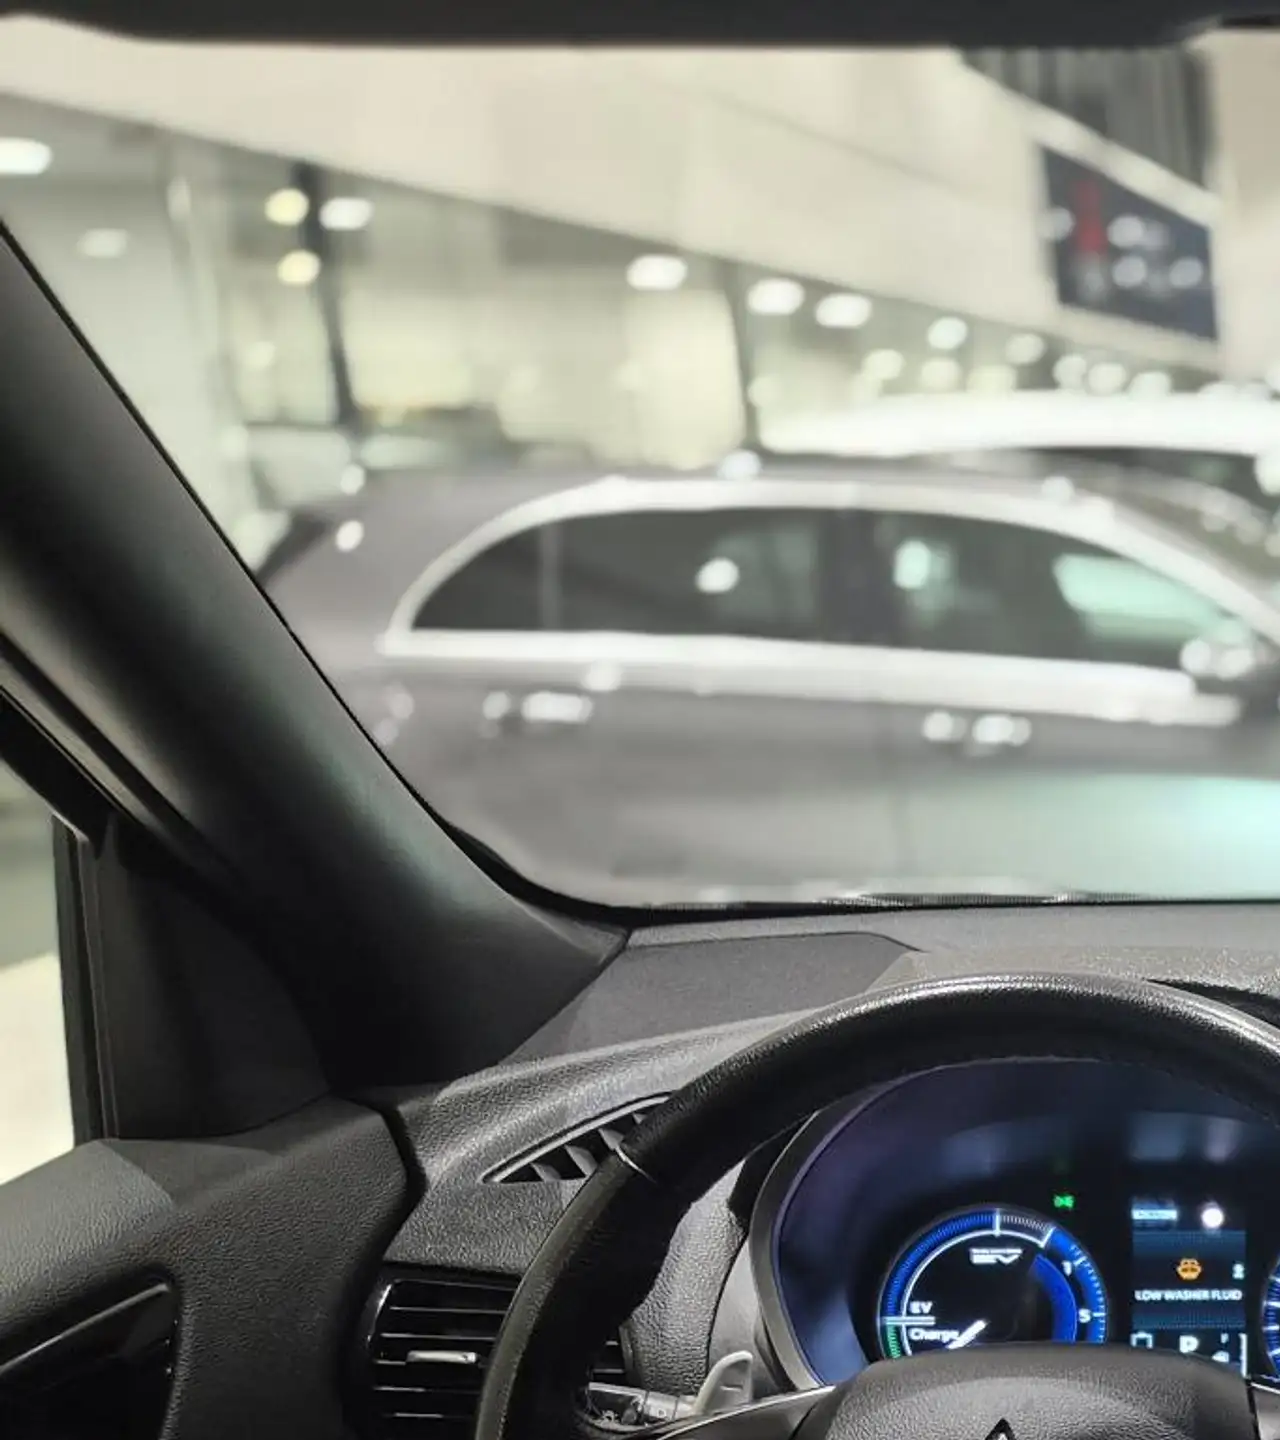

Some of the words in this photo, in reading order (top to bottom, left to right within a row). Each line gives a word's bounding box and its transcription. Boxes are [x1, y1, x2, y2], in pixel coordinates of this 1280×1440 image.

[1134, 1289, 1162, 1301] LOW
[1164, 1289, 1209, 1301] WASHER
[909, 1301, 933, 1314] EV
